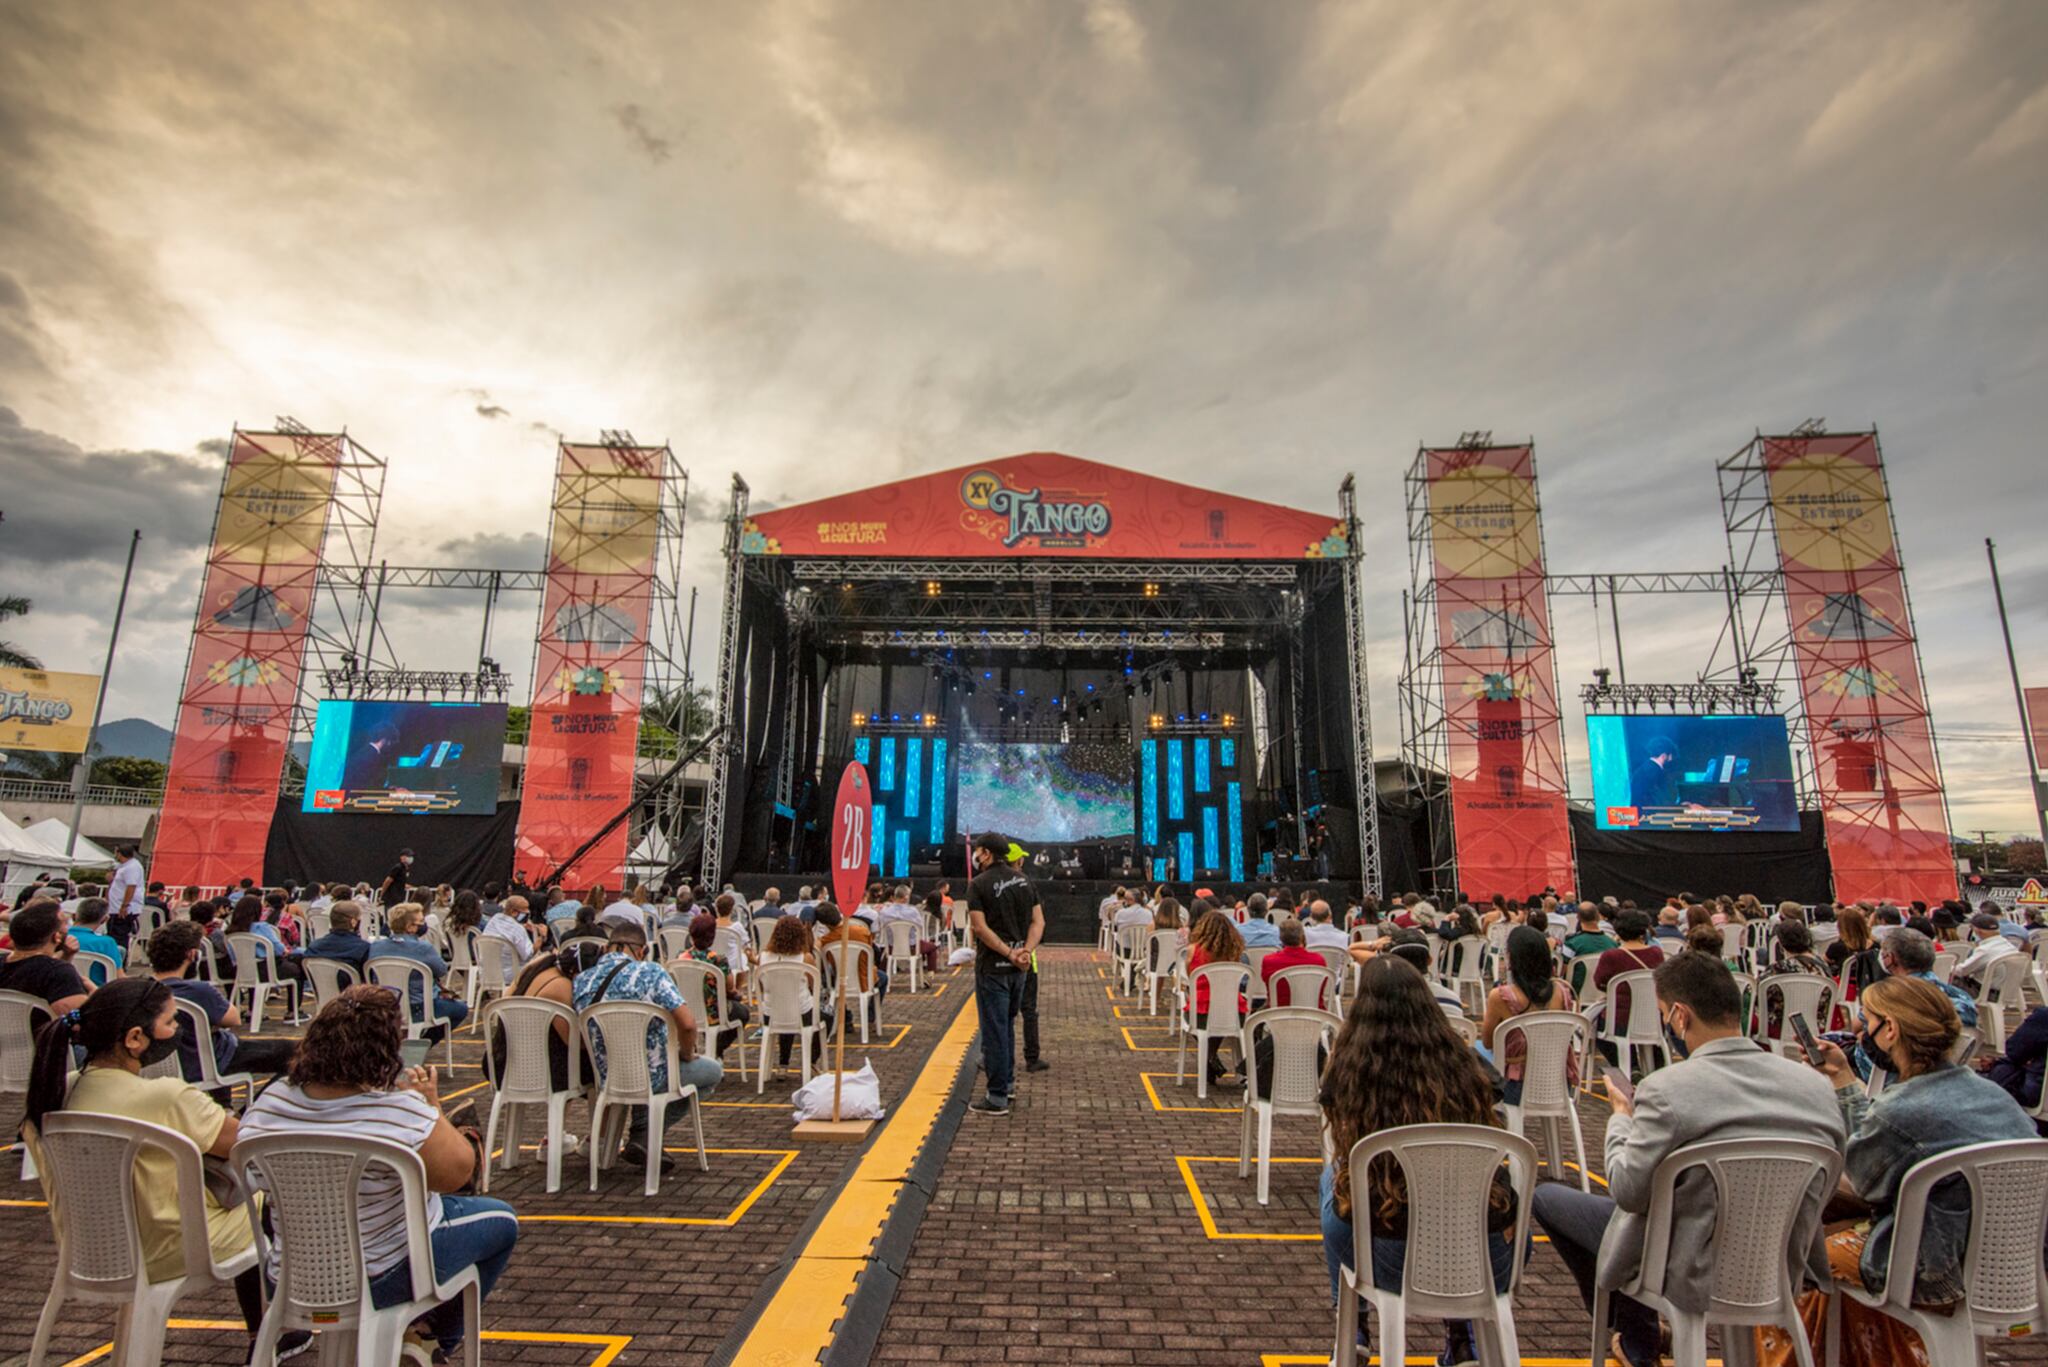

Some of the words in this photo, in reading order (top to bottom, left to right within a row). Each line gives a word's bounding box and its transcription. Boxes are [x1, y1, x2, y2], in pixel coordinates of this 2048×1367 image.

[970, 482, 994, 499] XV
[988, 487, 1111, 545] TANGO
[841, 803, 864, 870] 2B
